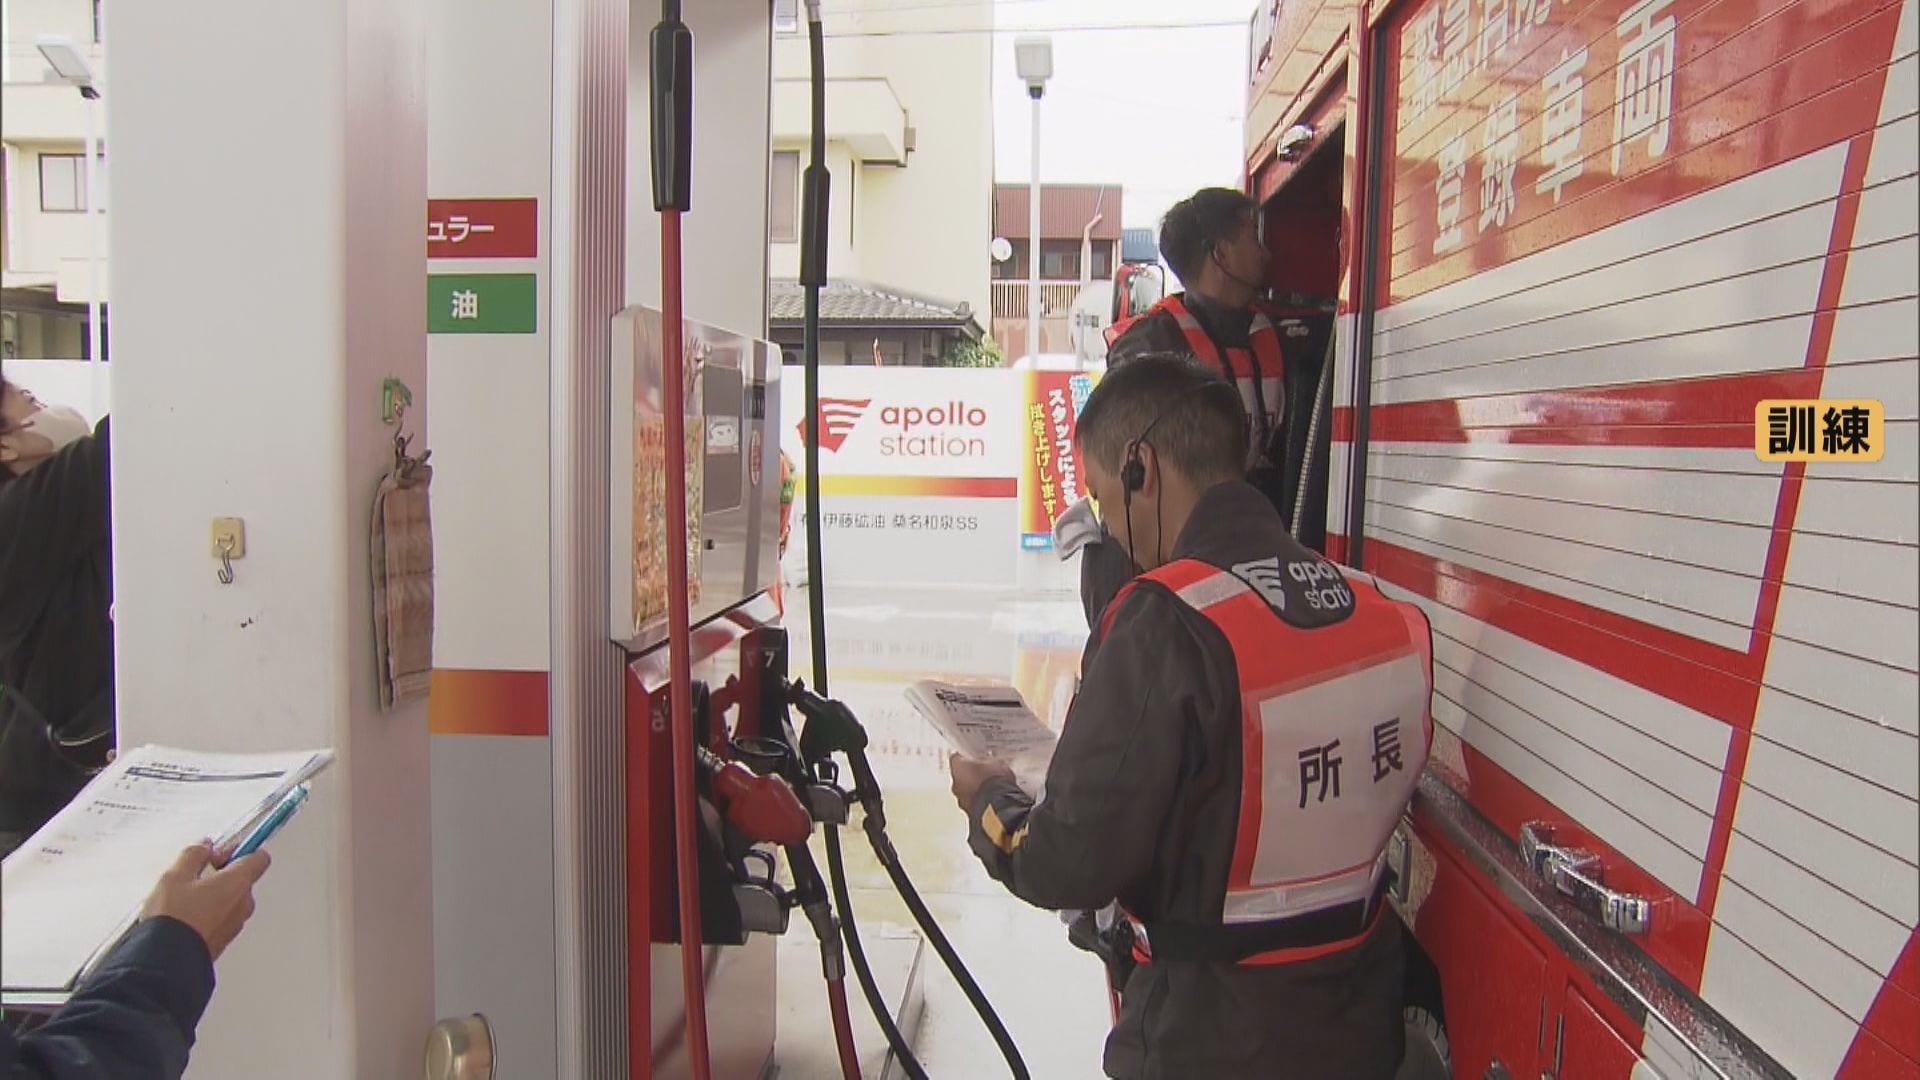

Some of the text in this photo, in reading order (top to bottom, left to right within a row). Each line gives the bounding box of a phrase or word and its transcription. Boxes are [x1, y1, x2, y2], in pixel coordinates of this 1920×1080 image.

[1433, 0, 1678, 255] 登録車両
[427, 217, 495, 242] ュラー
[451, 289, 478, 319] 油
[880, 401, 986, 432] apollo
[880, 432, 985, 456] station
[1048, 388, 1078, 508] スタッフによる
[764, 651, 775, 668] 7
[1299, 717, 1403, 809] 所長
